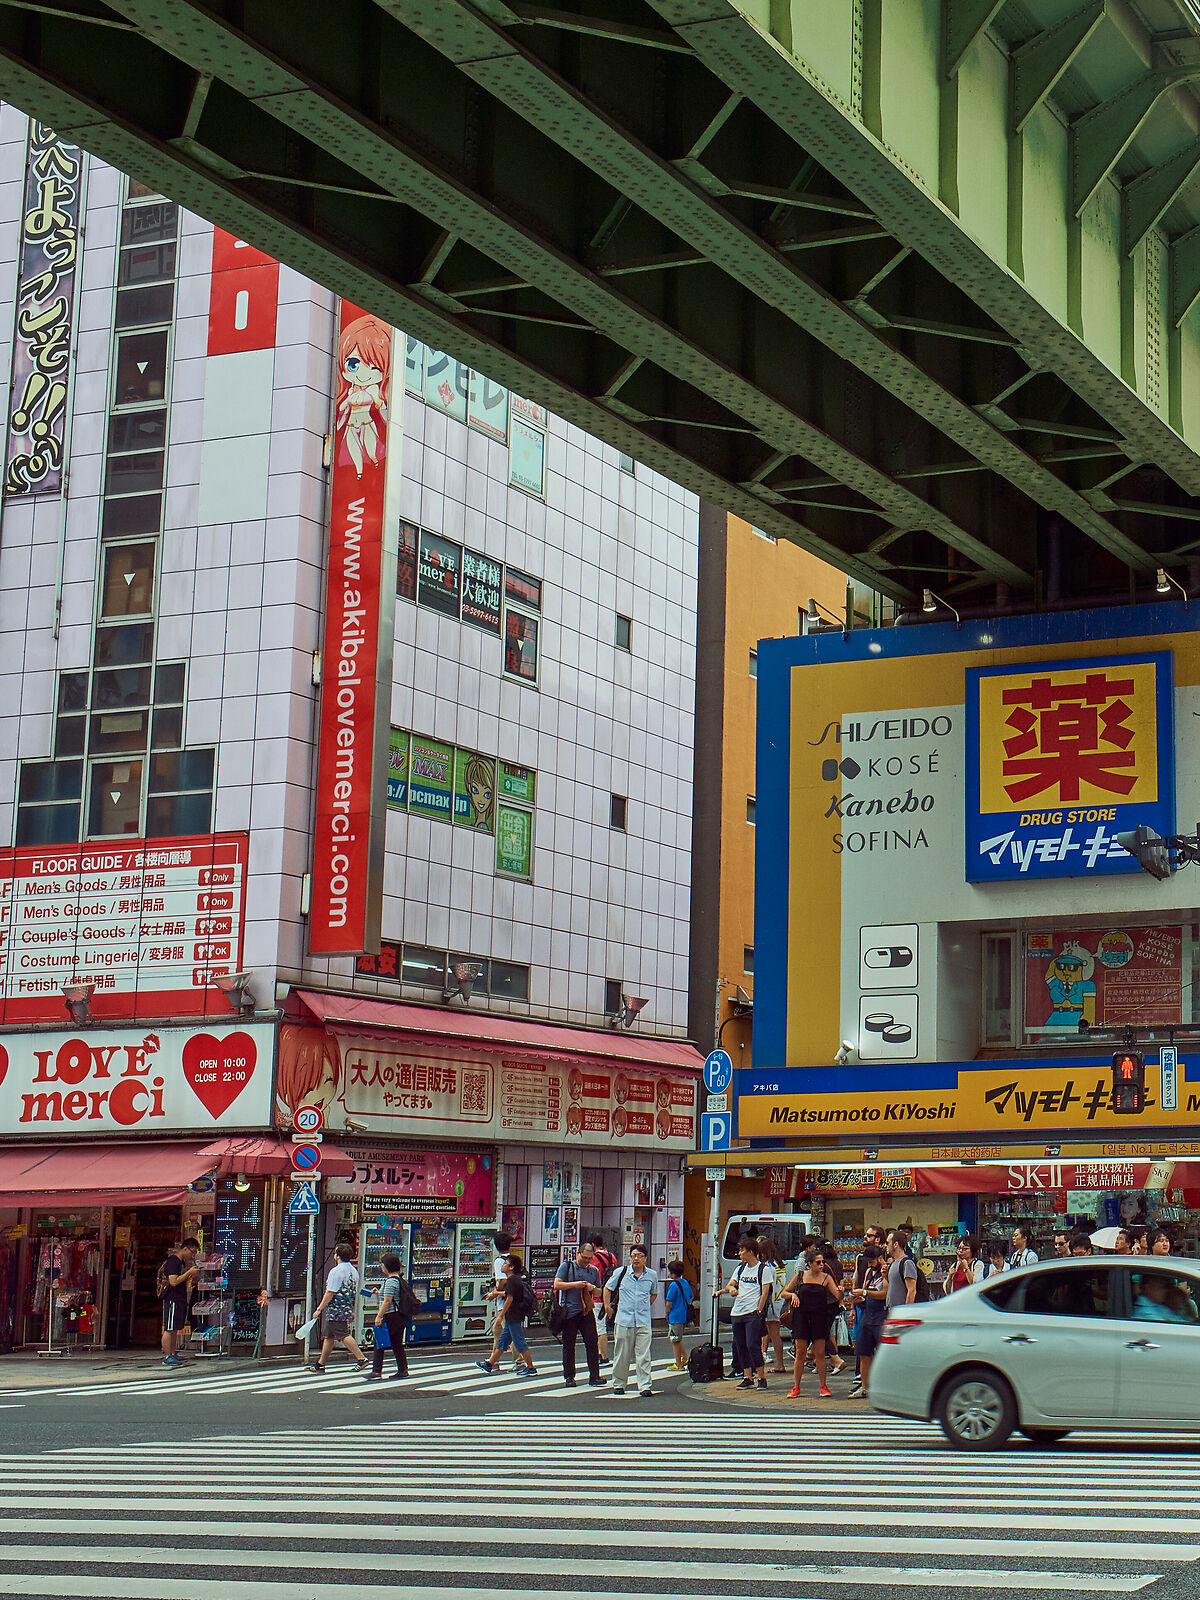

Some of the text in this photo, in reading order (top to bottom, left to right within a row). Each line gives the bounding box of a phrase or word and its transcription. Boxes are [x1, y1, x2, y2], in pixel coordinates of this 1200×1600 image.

[464, 554, 501, 587] 業者様
[463, 578, 500, 611] 大歓迎
[328, 496, 366, 928] www.akibalovemerci.com
[808, 716, 952, 746] SHISEIDO
[1002, 674, 1139, 803] 薬
[414, 756, 448, 783] MAX
[869, 749, 939, 777] KOSÉ
[824, 788, 935, 819] Kanebo
[1020, 808, 1117, 826] DRUG STORE
[832, 828, 929, 854] SOFINA
[979, 826, 1133, 872] マツモトキヨ
[32, 858, 77, 874] FLOOR
[82, 855, 123, 871] GUIDE
[25, 873, 166, 895] Men's Goods 男性用品
[212, 871, 230, 884] Only
[23, 898, 165, 920] Men's Goods 男性用品
[211, 896, 228, 908] Only
[21, 921, 186, 945] Couple's Goods 女士用品
[215, 921, 228, 931] OK
[215, 946, 227, 956] OK
[1063, 940, 1080, 950] MK
[20, 946, 185, 968] Costume Lingerie 変身服
[1136, 950, 1172, 967] SOFINA
[18, 977, 59, 992] Fetish
[32, 1038, 153, 1085] LOVE
[199, 1057, 246, 1069] OPEN 10:00
[194, 1071, 246, 1083] CLOSE 22:00
[350, 1058, 458, 1094] 大人の通信販売
[709, 1060, 721, 1087] P
[716, 1074, 725, 1087] 60
[752, 1084, 779, 1092] アキバ店
[383, 1091, 429, 1109] やってます
[300, 1113, 317, 1127] 20
[769, 1102, 957, 1123] Matsumoto KiYoshi
[709, 1117, 726, 1150] P
[368, 1152, 425, 1162] AMUSEMENT PARK
[931, 1147, 1001, 1159] 日本最大的药店
[1131, 1144, 1154, 1154] No.1
[1075, 1163, 1134, 1173] 正規取扱店
[1075, 1174, 1134, 1187] 正规品牌店
